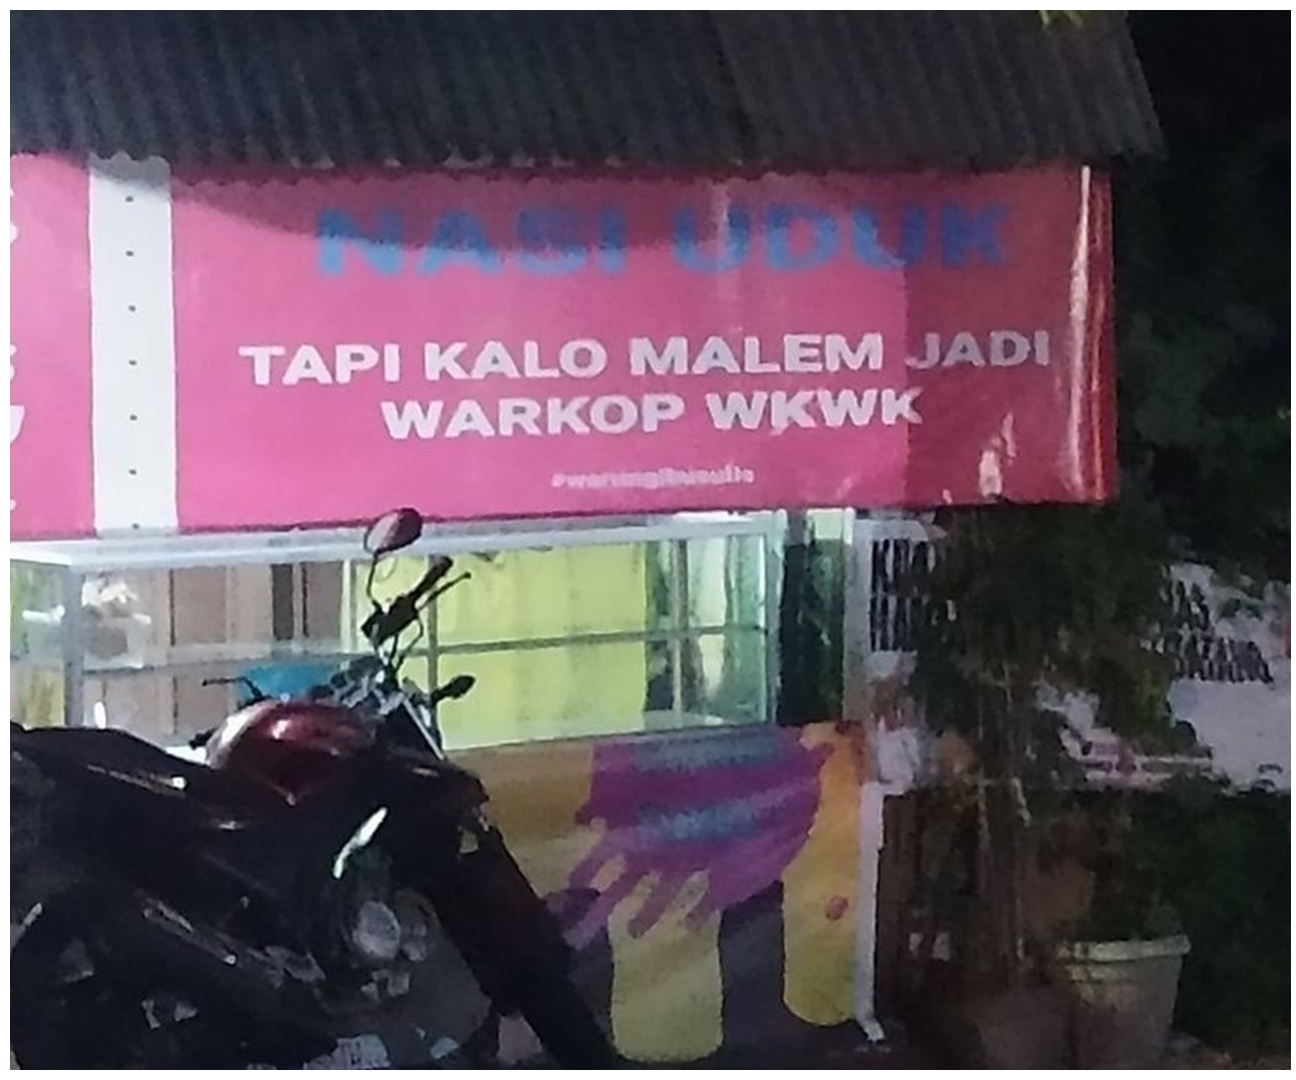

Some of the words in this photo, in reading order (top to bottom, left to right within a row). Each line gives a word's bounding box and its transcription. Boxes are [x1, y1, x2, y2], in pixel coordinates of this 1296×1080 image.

[316, 208, 627, 278] NASI
[671, 201, 1010, 274] UDUK
[239, 343, 401, 386] TAPI
[424, 336, 608, 382] KALO
[628, 331, 884, 377] MALEM
[904, 329, 1051, 370] JADI
[379, 392, 686, 440] WARKOP
[704, 386, 924, 431] WKWK
